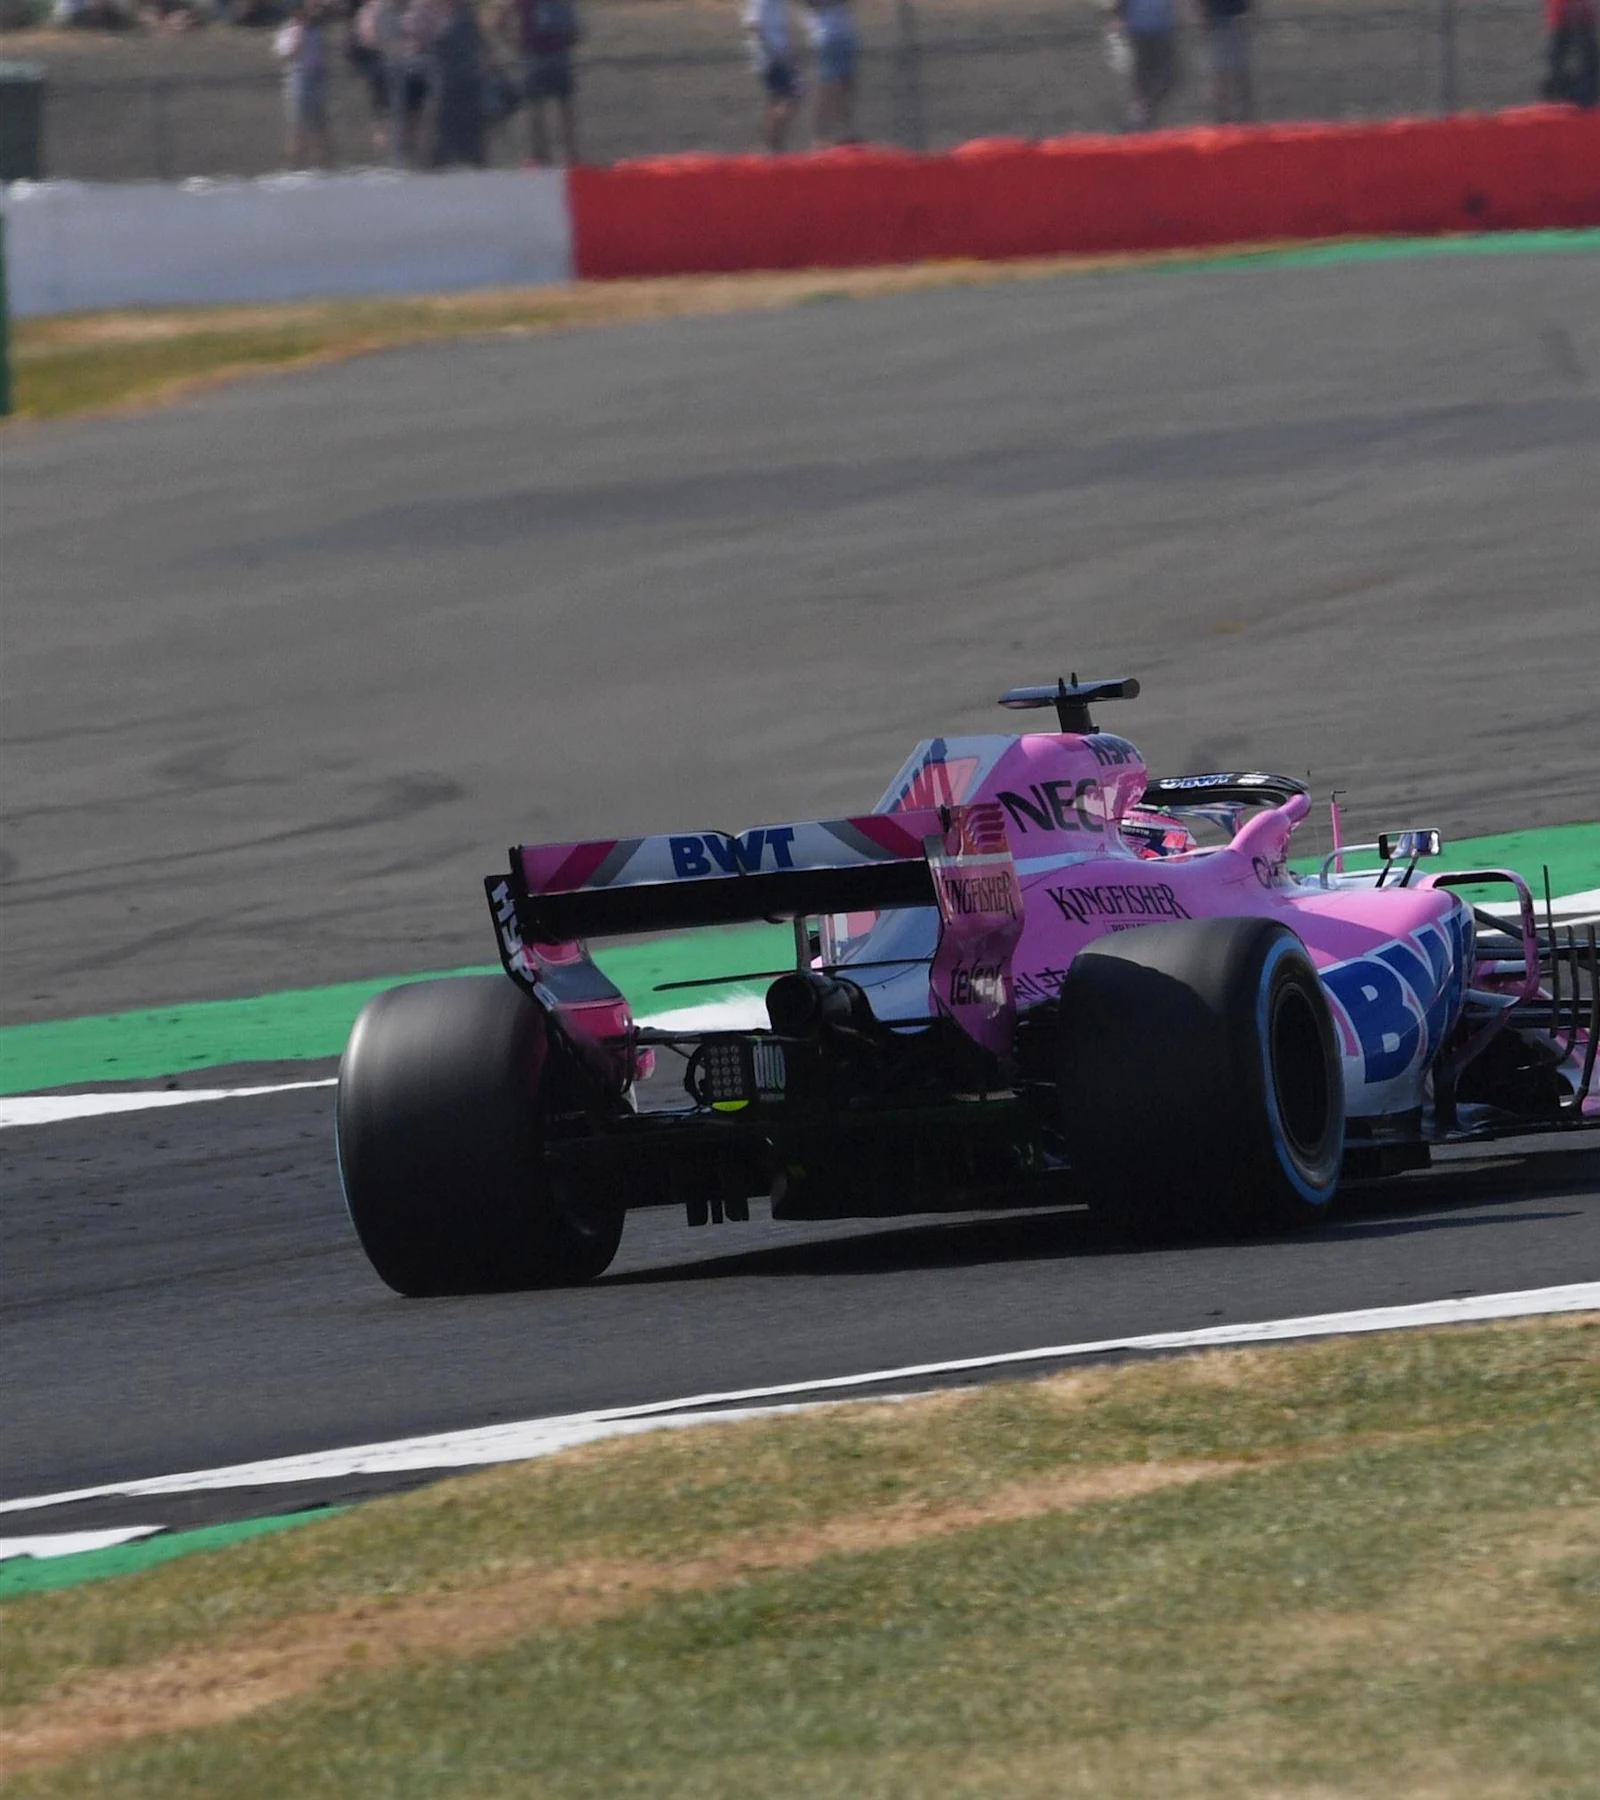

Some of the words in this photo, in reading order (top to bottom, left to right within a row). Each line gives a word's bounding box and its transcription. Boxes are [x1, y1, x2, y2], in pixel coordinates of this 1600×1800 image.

[996, 778, 1105, 833] NEC
[669, 827, 796, 878] BWT
[1045, 883, 1193, 925] KINGFISHER
